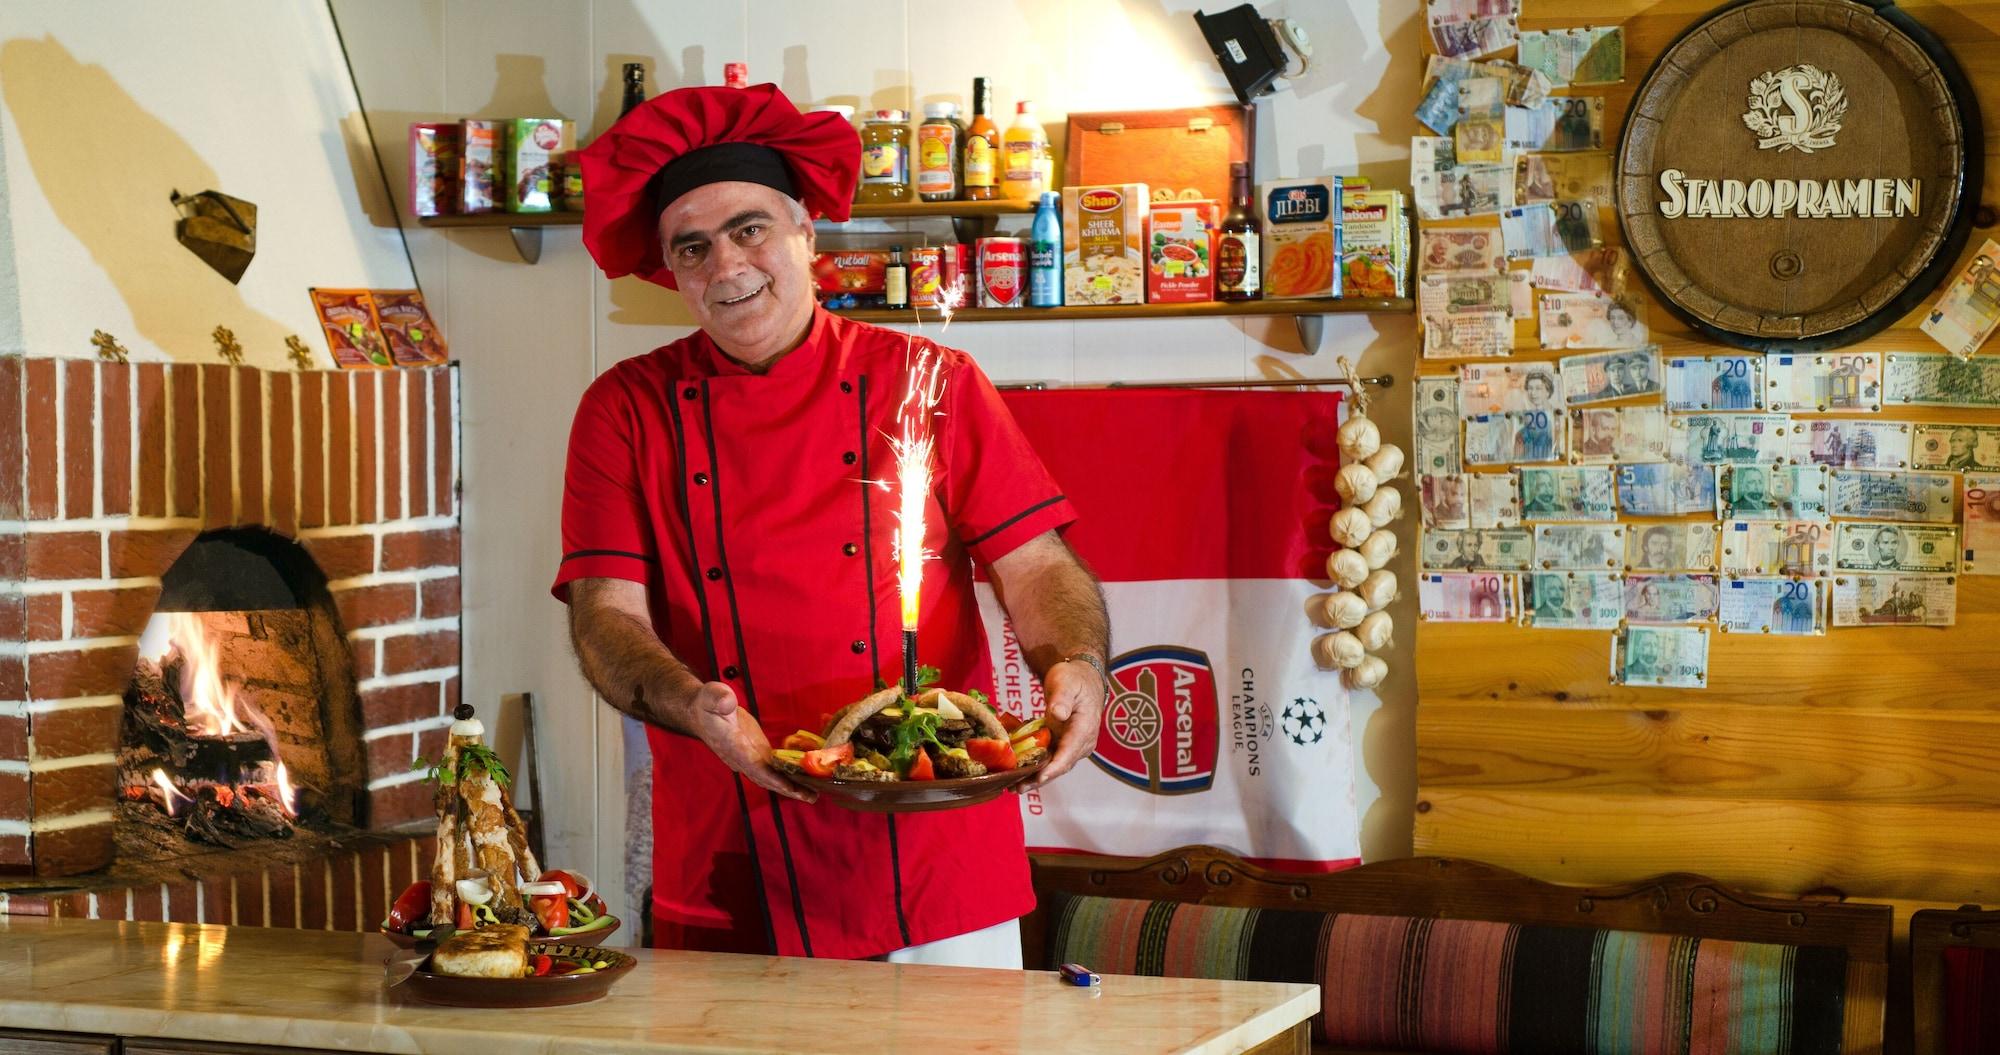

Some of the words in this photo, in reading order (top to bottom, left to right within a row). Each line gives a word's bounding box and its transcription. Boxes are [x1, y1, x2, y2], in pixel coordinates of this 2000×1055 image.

[1566, 99, 1587, 118] 20
[1083, 195, 1118, 207] Shan
[1660, 169, 1922, 219] STAROPRAMEN
[1276, 198, 1321, 218] JILEBI
[1081, 228, 1121, 237] KHURMA
[1088, 220, 1115, 229] SHEER
[912, 253, 939, 266] Ligo
[1161, 281, 1177, 289] Pickle
[1178, 281, 1200, 289] Powder
[1724, 359, 1747, 378] 20
[1839, 356, 1866, 375] 50
[1463, 369, 1480, 382] £10
[1525, 411, 1548, 430] 20
[1623, 466, 1636, 484] 5
[1800, 501, 1821, 511] 100
[1967, 488, 1986, 509] 10
[1795, 524, 1821, 542] 50
[1697, 554, 1711, 567] 10
[1481, 576, 1500, 594] 10
[1784, 582, 1809, 601] 20
[1600, 608, 1618, 618] 100
[1679, 665, 1699, 676] 100
[1172, 666, 1198, 775] Arsenal
[1231, 694, 1245, 750] LEAGUE
[1242, 667, 1261, 777] CHAMPIONS
[1259, 704, 1272, 738] UEFA
[1027, 787, 1043, 816] ED
